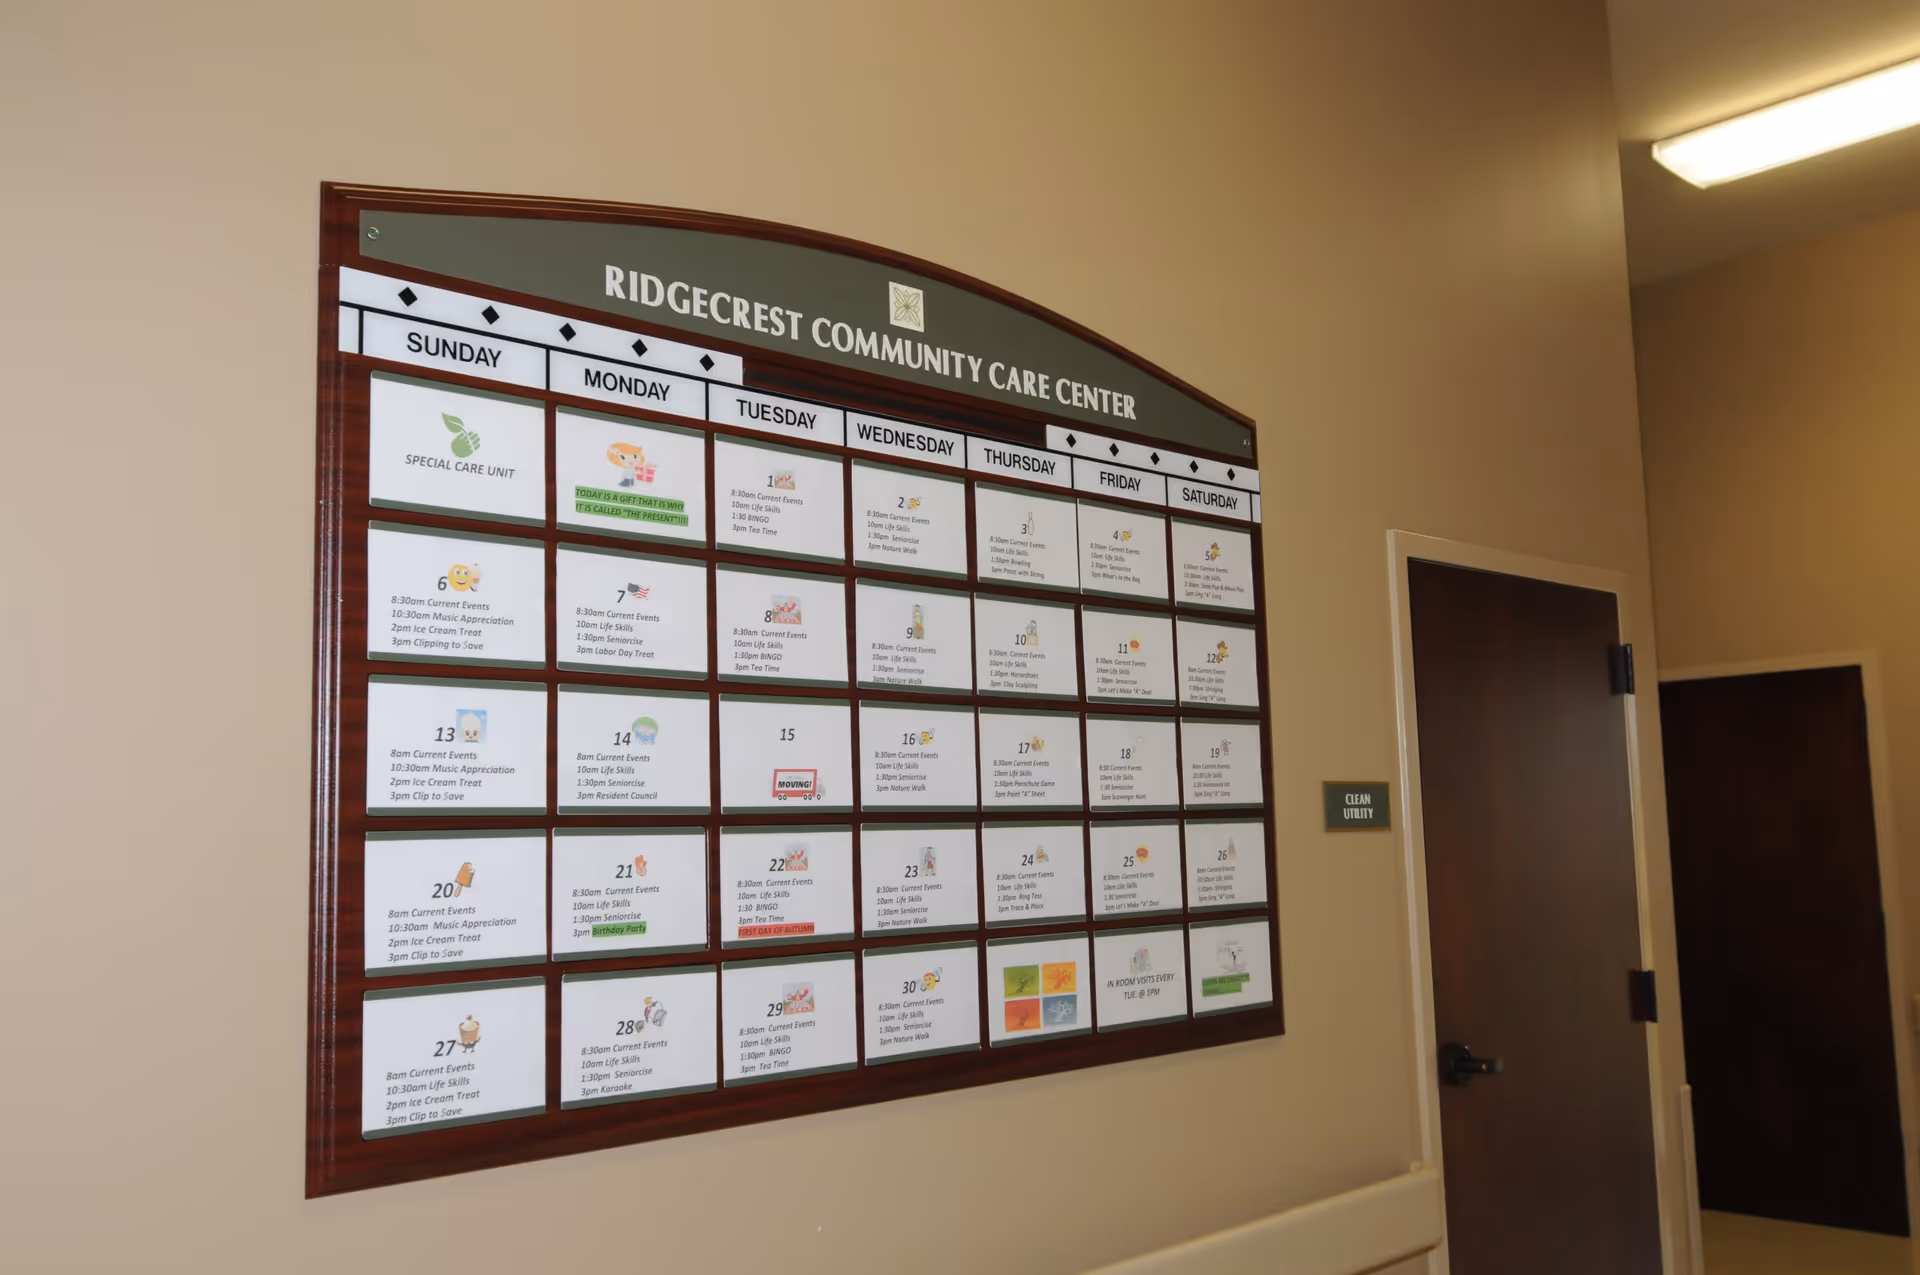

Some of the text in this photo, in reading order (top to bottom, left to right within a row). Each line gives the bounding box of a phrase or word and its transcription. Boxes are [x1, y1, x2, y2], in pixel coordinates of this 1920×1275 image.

[605, 264, 1136, 420] RIDGECREST COMMUNITY CARE CENTER
[407, 332, 502, 368] SUNDAY
[584, 368, 671, 401] MONDAY
[737, 399, 817, 430] TUESDAY
[857, 423, 954, 457] WEDNESDAY
[404, 453, 515, 478] SPECIAL CARE UNIT
[984, 448, 1056, 476] THURSDAY
[766, 474, 773, 487] 1
[1100, 471, 1141, 492] FRIDAY
[575, 488, 684, 511] TODAY IS A GIFT THAT IS WHY
[756, 492, 781, 502] Current
[782, 495, 803, 505] Events
[897, 496, 904, 508] 2
[1182, 487, 1238, 510] SATURDAY
[575, 502, 584, 511] IT
[584, 503, 591, 512] IS
[592, 505, 621, 516] CALLED
[731, 500, 780, 513] 10am Life Skills
[747, 513, 769, 523] BINGO
[731, 523, 777, 536] 3pm Tea Time
[1021, 523, 1027, 534] 3
[1112, 530, 1118, 540] 4
[1204, 550, 1210, 561] 5
[437, 575, 447, 591] 6
[390, 595, 489, 610] 8:30am Current Events
[616, 589, 625, 603] 7
[391, 608, 514, 625] 10:30am Music Appreciation
[575, 606, 659, 622] 8:30am Current Events
[763, 609, 772, 623] 8
[390, 622, 482, 636] 2pm Ice Cream Treat
[575, 619, 633, 632] 10am Life Skills
[906, 626, 913, 638] 9
[391, 636, 411, 647] 3pm
[413, 637, 449, 650] Clipping
[451, 640, 460, 648] to
[576, 632, 643, 645] 1:30pm Seniorcise
[1014, 633, 1026, 645] 10
[576, 644, 654, 658] 3pm Labor Day Treat
[1117, 643, 1127, 654] 11
[1206, 652, 1216, 663] 12
[434, 726, 455, 742] 13
[613, 731, 631, 745] 14
[779, 727, 794, 741] 15
[902, 732, 915, 745] 16
[389, 748, 477, 760] 8am Current Events
[1018, 742, 1030, 753] 17
[1120, 748, 1131, 759] 18
[1210, 747, 1220, 758] 19
[576, 752, 650, 762] 8am Current Events
[390, 762, 515, 775] 10:30am Music Appreciation
[576, 765, 634, 775] 10am Life Skills
[389, 776, 482, 787] 2pm Ice Cream Treat
[576, 778, 645, 788] 1:30pm Seniorcise
[777, 780, 812, 788] MOVING!
[576, 791, 657, 800] 3pm Resident Council
[1345, 794, 1371, 805] CLEAN
[1343, 808, 1373, 819] UTILITY
[1021, 854, 1033, 866] 24
[1122, 855, 1134, 867] 25
[1217, 849, 1227, 860] 26
[615, 863, 632, 878] 21
[768, 857, 785, 871] 22
[904, 864, 918, 878] 23
[431, 882, 454, 898] 20
[604, 887, 633, 895] Current
[635, 885, 659, 893] Events
[572, 898, 631, 910] 10am Life Skills
[572, 924, 646, 938] 3pm Birthday Party
[901, 980, 916, 994] 30
[1106, 972, 1174, 988] IN ROOM VISITS EVERY
[1138, 989, 1145, 998] @
[1146, 987, 1160, 996] 1PM
[766, 1002, 782, 1017] 29
[615, 1019, 634, 1035] 28
[433, 1039, 456, 1057] 27
[385, 1076, 470, 1095] 10:30am Life Skills
[580, 1081, 632, 1097] 3pm Karaoke
[385, 1089, 480, 1112] 2pm Ice Cream Treat
